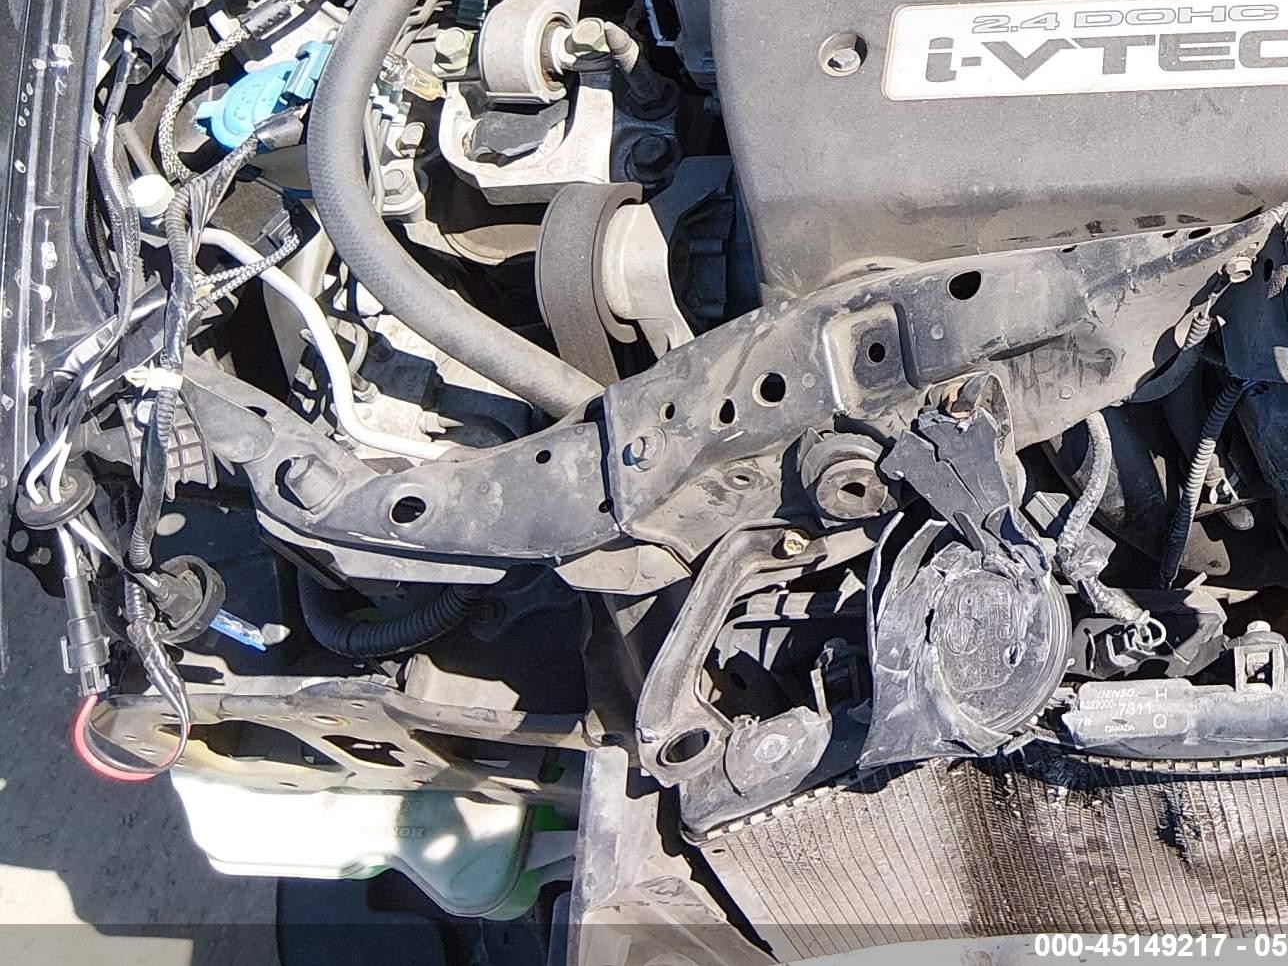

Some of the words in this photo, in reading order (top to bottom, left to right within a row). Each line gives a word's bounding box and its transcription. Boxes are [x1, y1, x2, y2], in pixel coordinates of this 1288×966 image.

[972, 11, 1060, 33] 2.4
[1073, 3, 1280, 28] DOHC
[1097, 687, 1136, 699] DENSO
